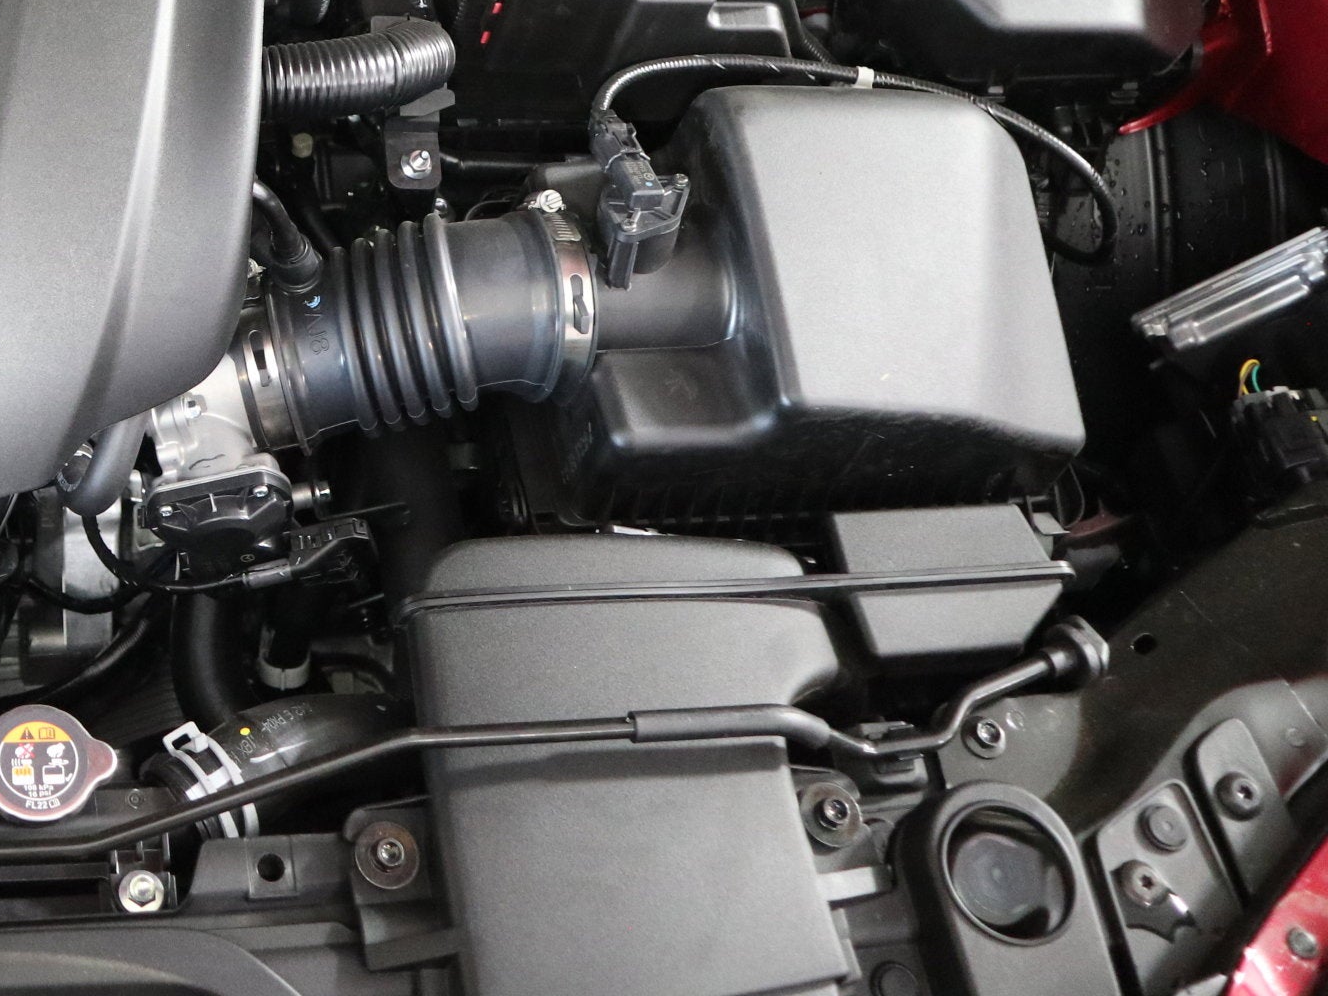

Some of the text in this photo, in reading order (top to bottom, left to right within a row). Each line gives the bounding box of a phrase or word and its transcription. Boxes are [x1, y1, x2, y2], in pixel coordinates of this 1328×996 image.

[38, 784, 55, 792] kPa
[28, 791, 52, 799] 16 psi
[25, 801, 49, 810] FL22
